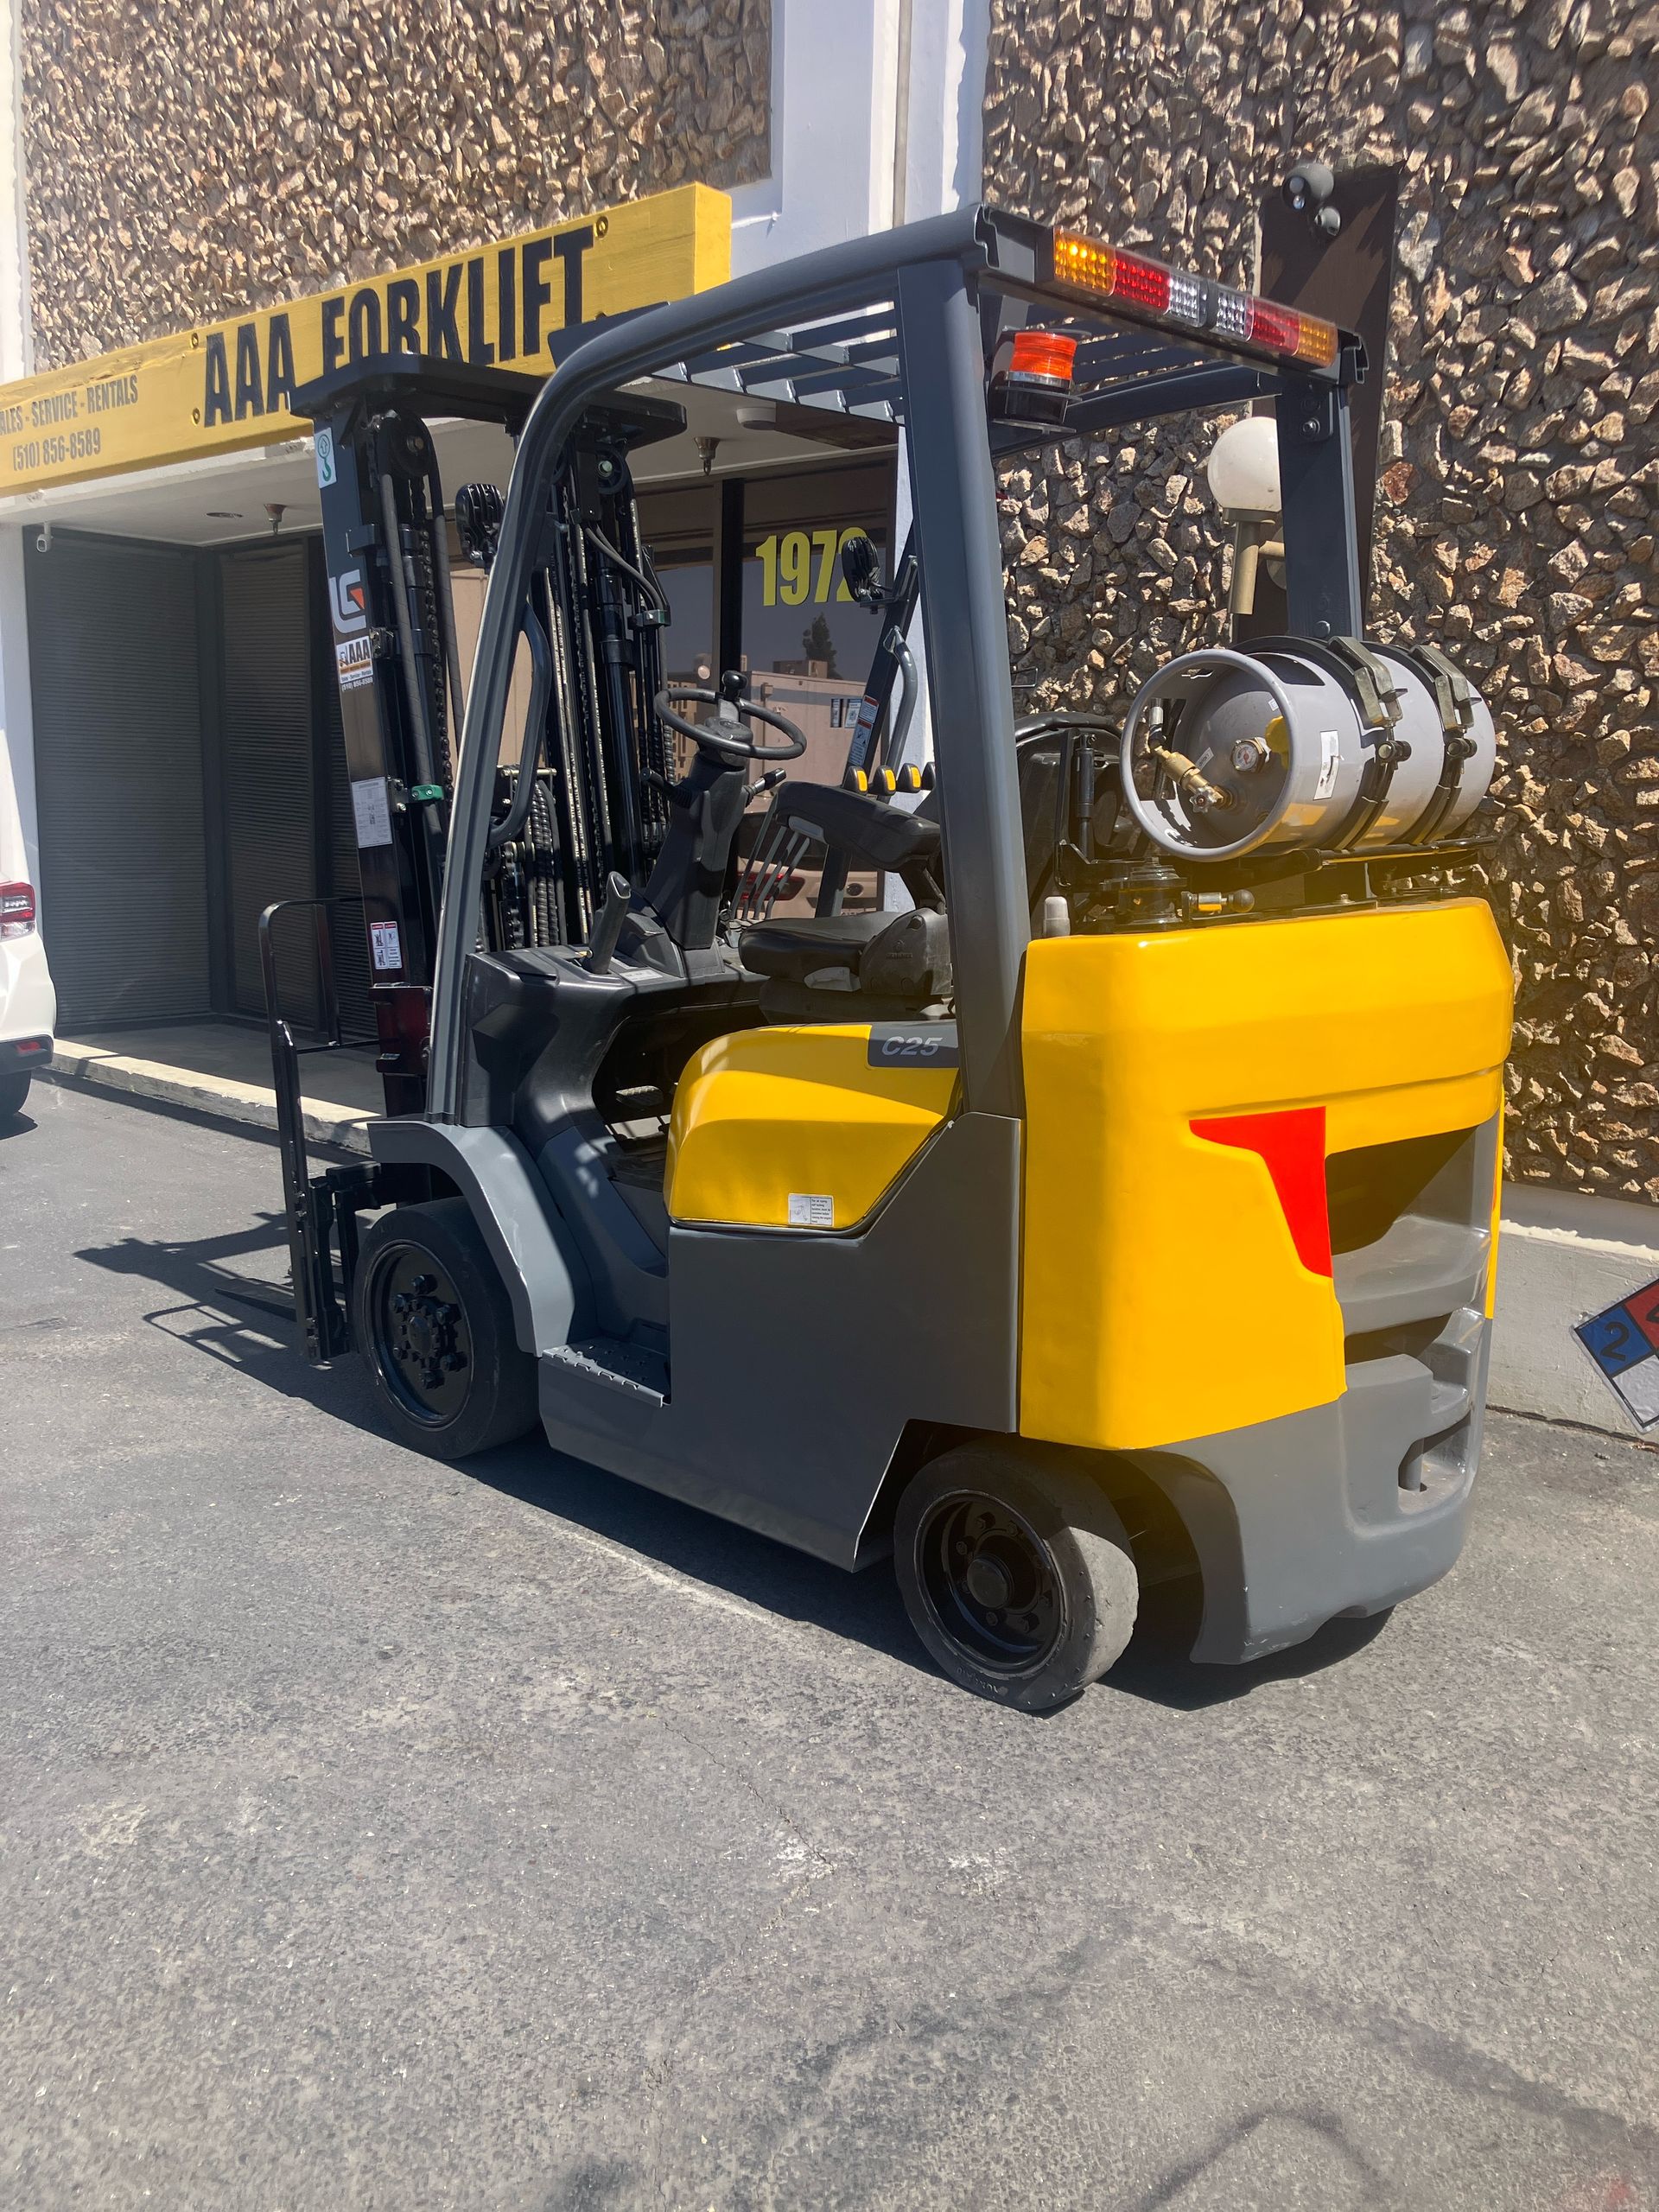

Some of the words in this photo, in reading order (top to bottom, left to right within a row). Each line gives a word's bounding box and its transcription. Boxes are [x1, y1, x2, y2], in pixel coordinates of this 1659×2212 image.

[204, 313, 296, 428] AAA
[321, 225, 594, 377] FORKLIFT
[31, 391, 78, 428] SERVICE
[86, 374, 138, 414] RENTALS
[13, 441, 41, 472] (510)
[43, 427, 101, 466] 856-8589
[881, 1036, 943, 1057] C25
[1600, 1321, 1630, 1362] 2
